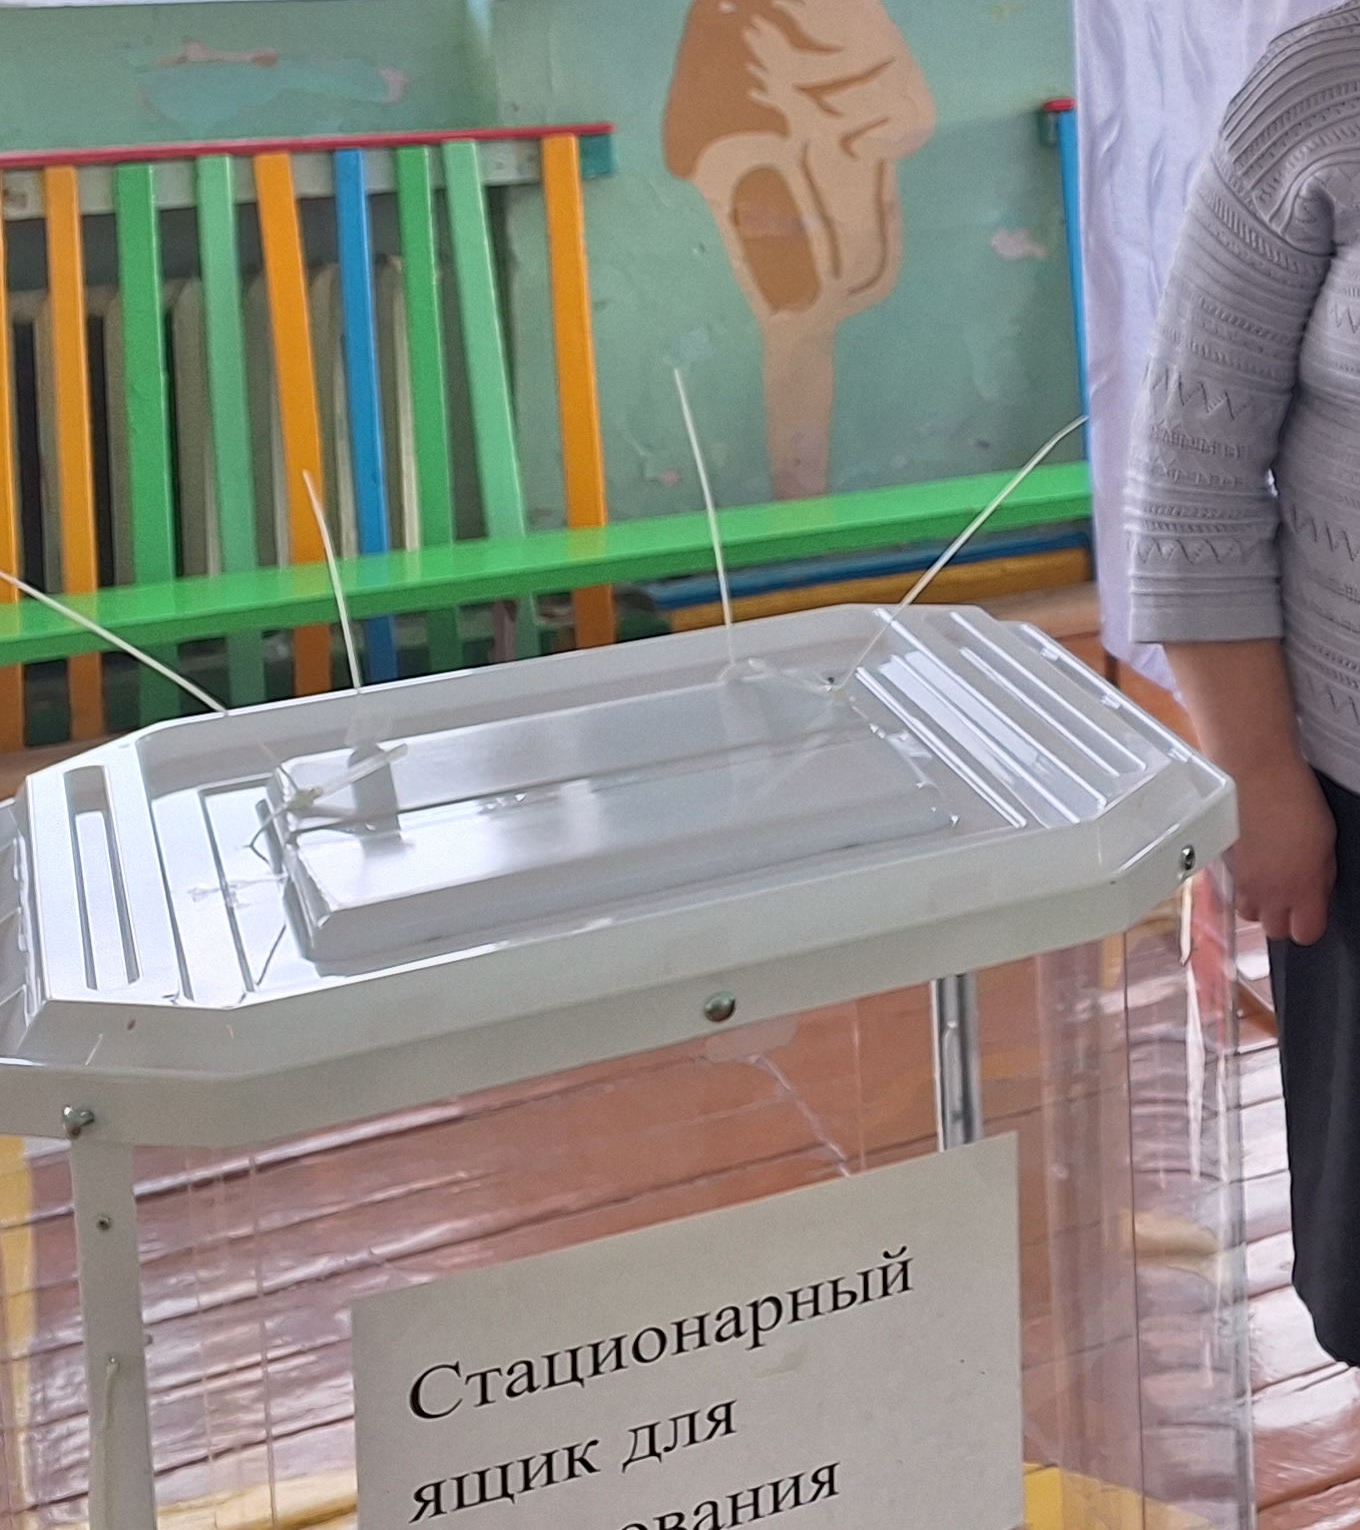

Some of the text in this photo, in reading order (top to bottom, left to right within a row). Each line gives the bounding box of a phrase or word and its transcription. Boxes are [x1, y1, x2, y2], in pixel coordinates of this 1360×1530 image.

[408, 1244, 913, 1421] Стационарный
[408, 1399, 738, 1525] ящик для
